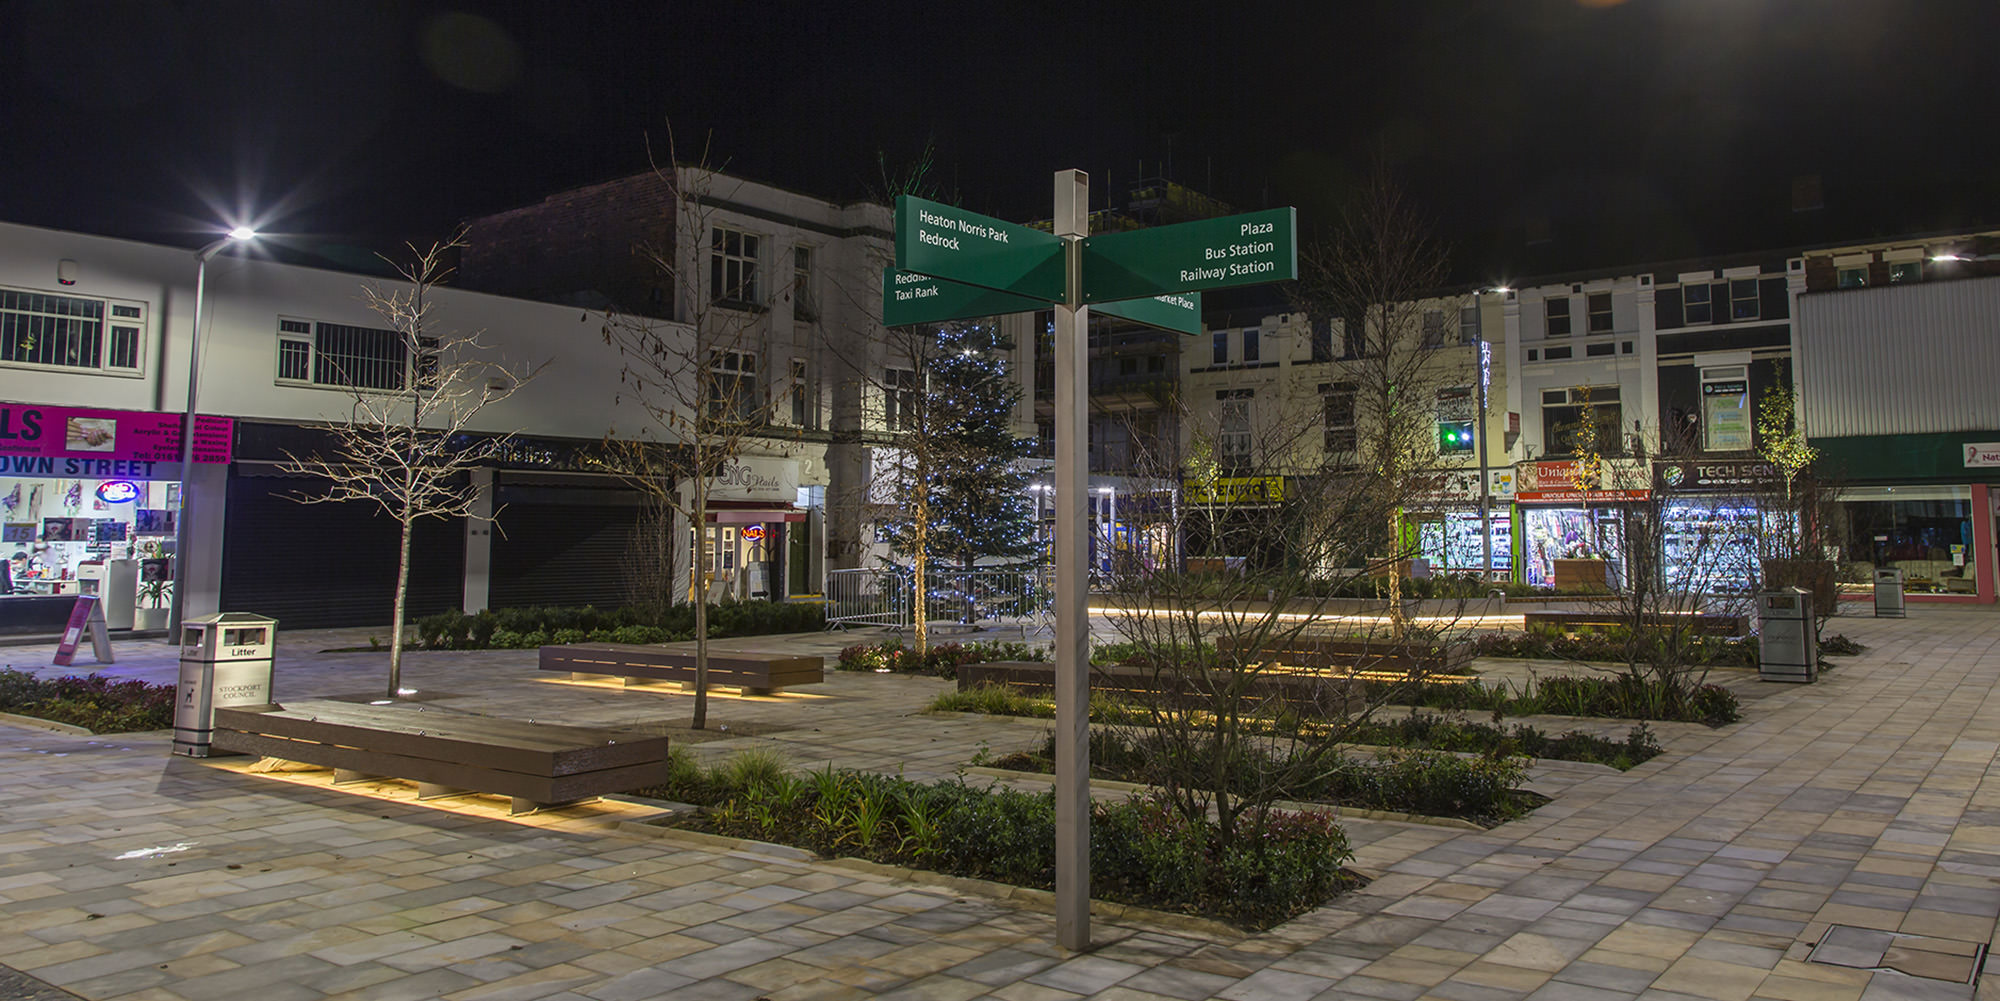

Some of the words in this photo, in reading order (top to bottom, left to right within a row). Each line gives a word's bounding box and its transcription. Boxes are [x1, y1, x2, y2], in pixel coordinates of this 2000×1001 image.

[919, 209, 956, 230] Heaton
[958, 219, 987, 238] Norris
[988, 227, 1009, 243] Park
[1240, 222, 1273, 236] Plaza
[919, 229, 960, 251] Redrock
[1205, 248, 1227, 260] Bus
[1229, 241, 1274, 257] Station
[1180, 267, 1227, 282] Railway
[1229, 260, 1274, 276] Station
[895, 288, 913, 301] Taxi
[915, 285, 938, 298] Rank
[1154, 295, 1178, 305] arket
[1178, 297, 1194, 310] Place
[65, 458, 157, 478] STREET
[804, 459, 812, 474] 2
[1697, 465, 1736, 477] TECH
[752, 474, 780, 487] Nails
[231, 648, 256, 656] Litter
[219, 684, 261, 692] STOCKPORT
[223, 691, 256, 699] COUNCIL
